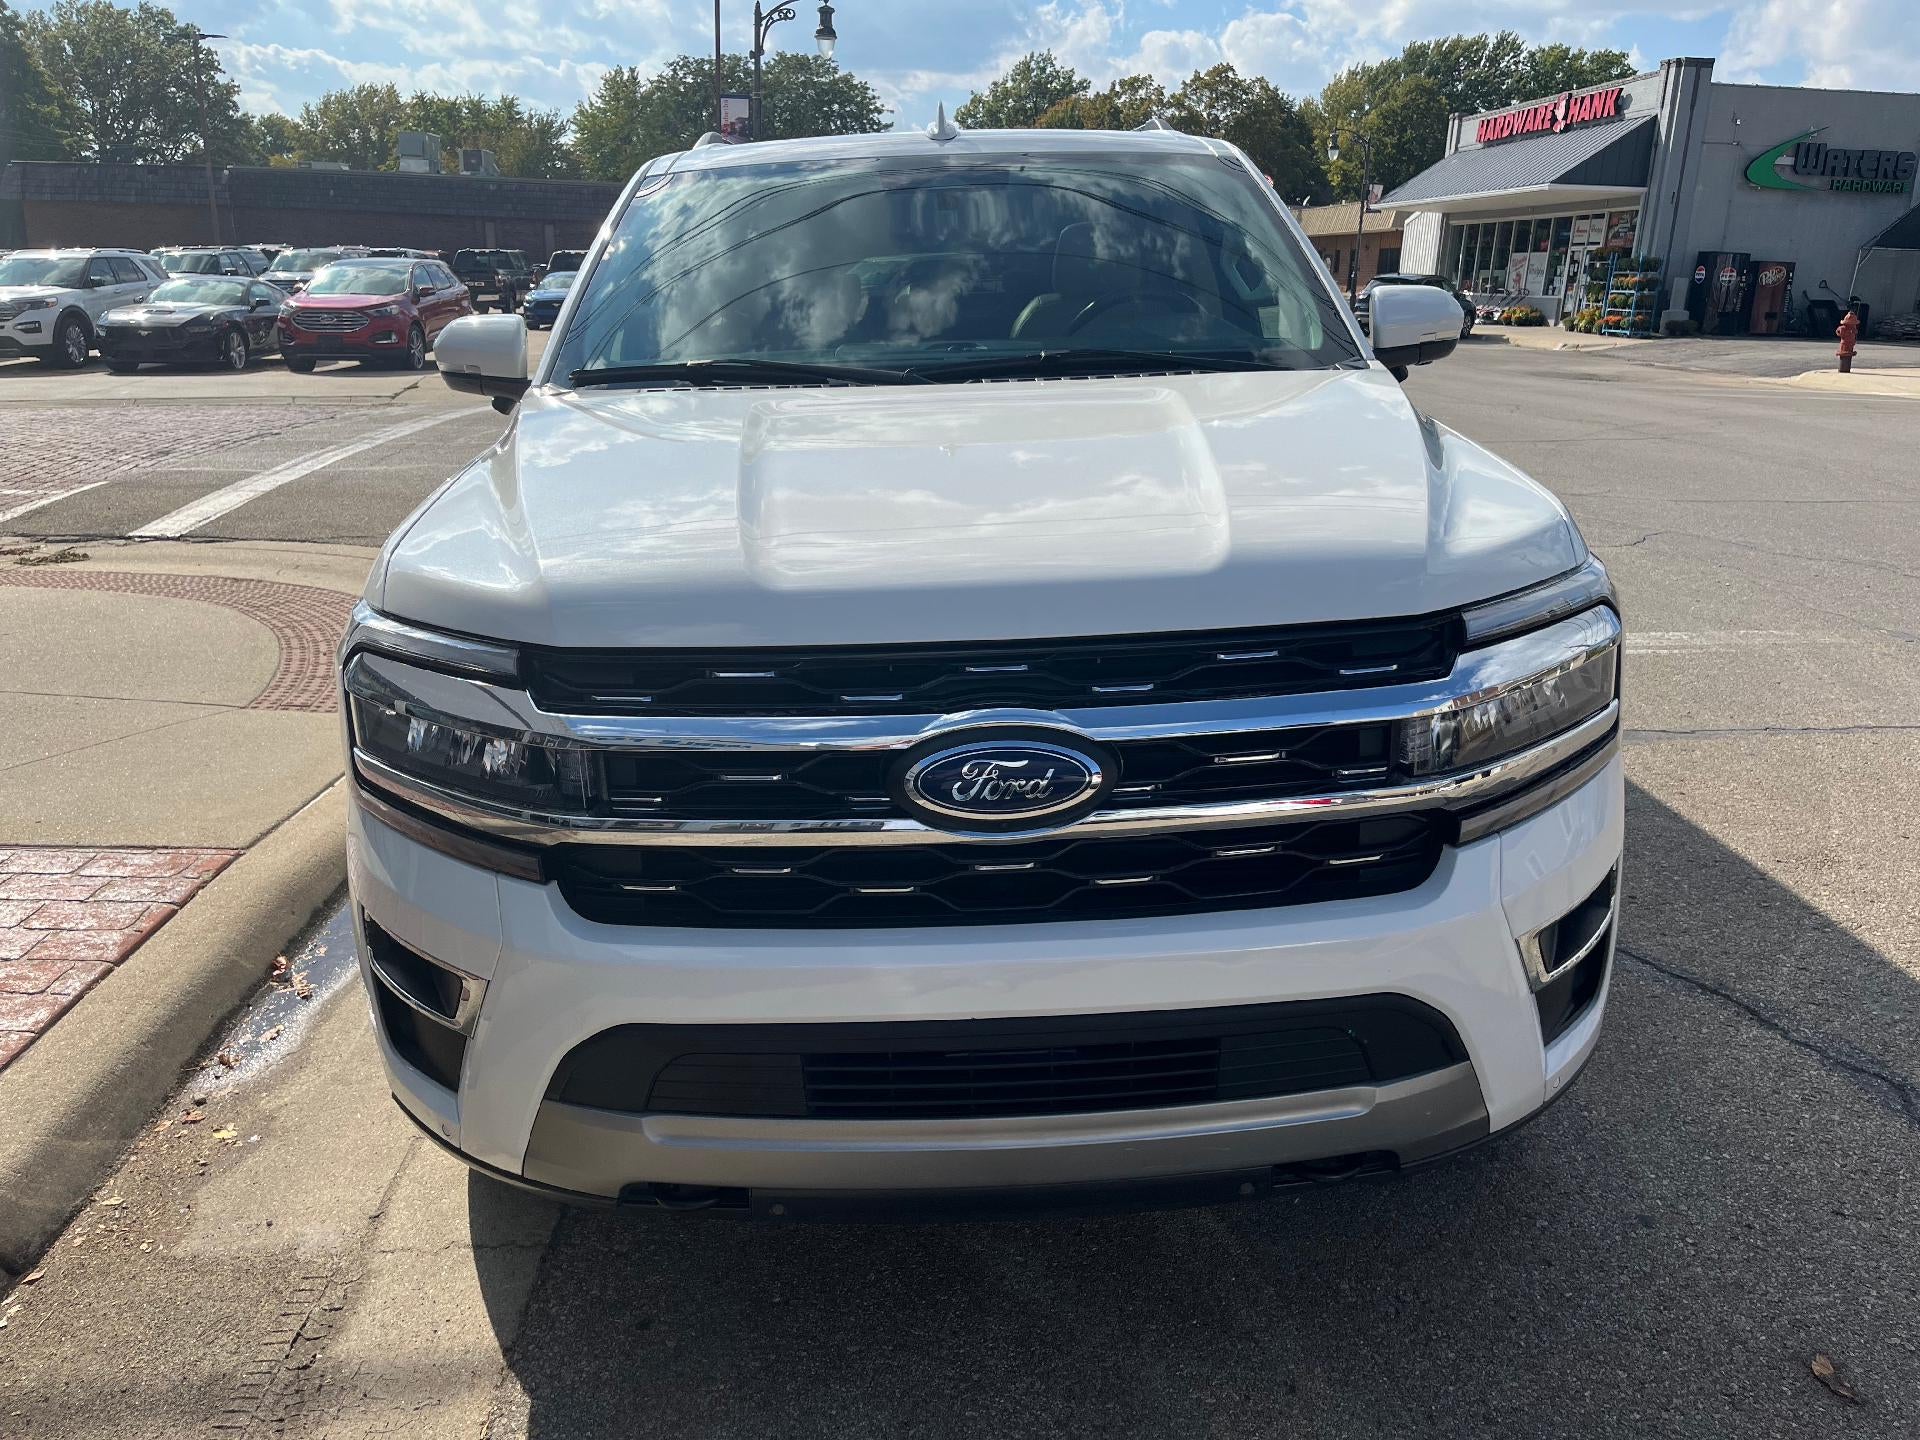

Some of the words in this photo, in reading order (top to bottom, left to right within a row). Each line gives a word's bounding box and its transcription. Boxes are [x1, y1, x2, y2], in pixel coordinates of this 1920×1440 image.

[1476, 102, 1554, 143] HARDWARE
[1567, 88, 1623, 124] HANK
[1794, 142, 1917, 179] WATERS
[1829, 179, 1911, 193] HARDWARE
[952, 760, 1055, 801] Ford
